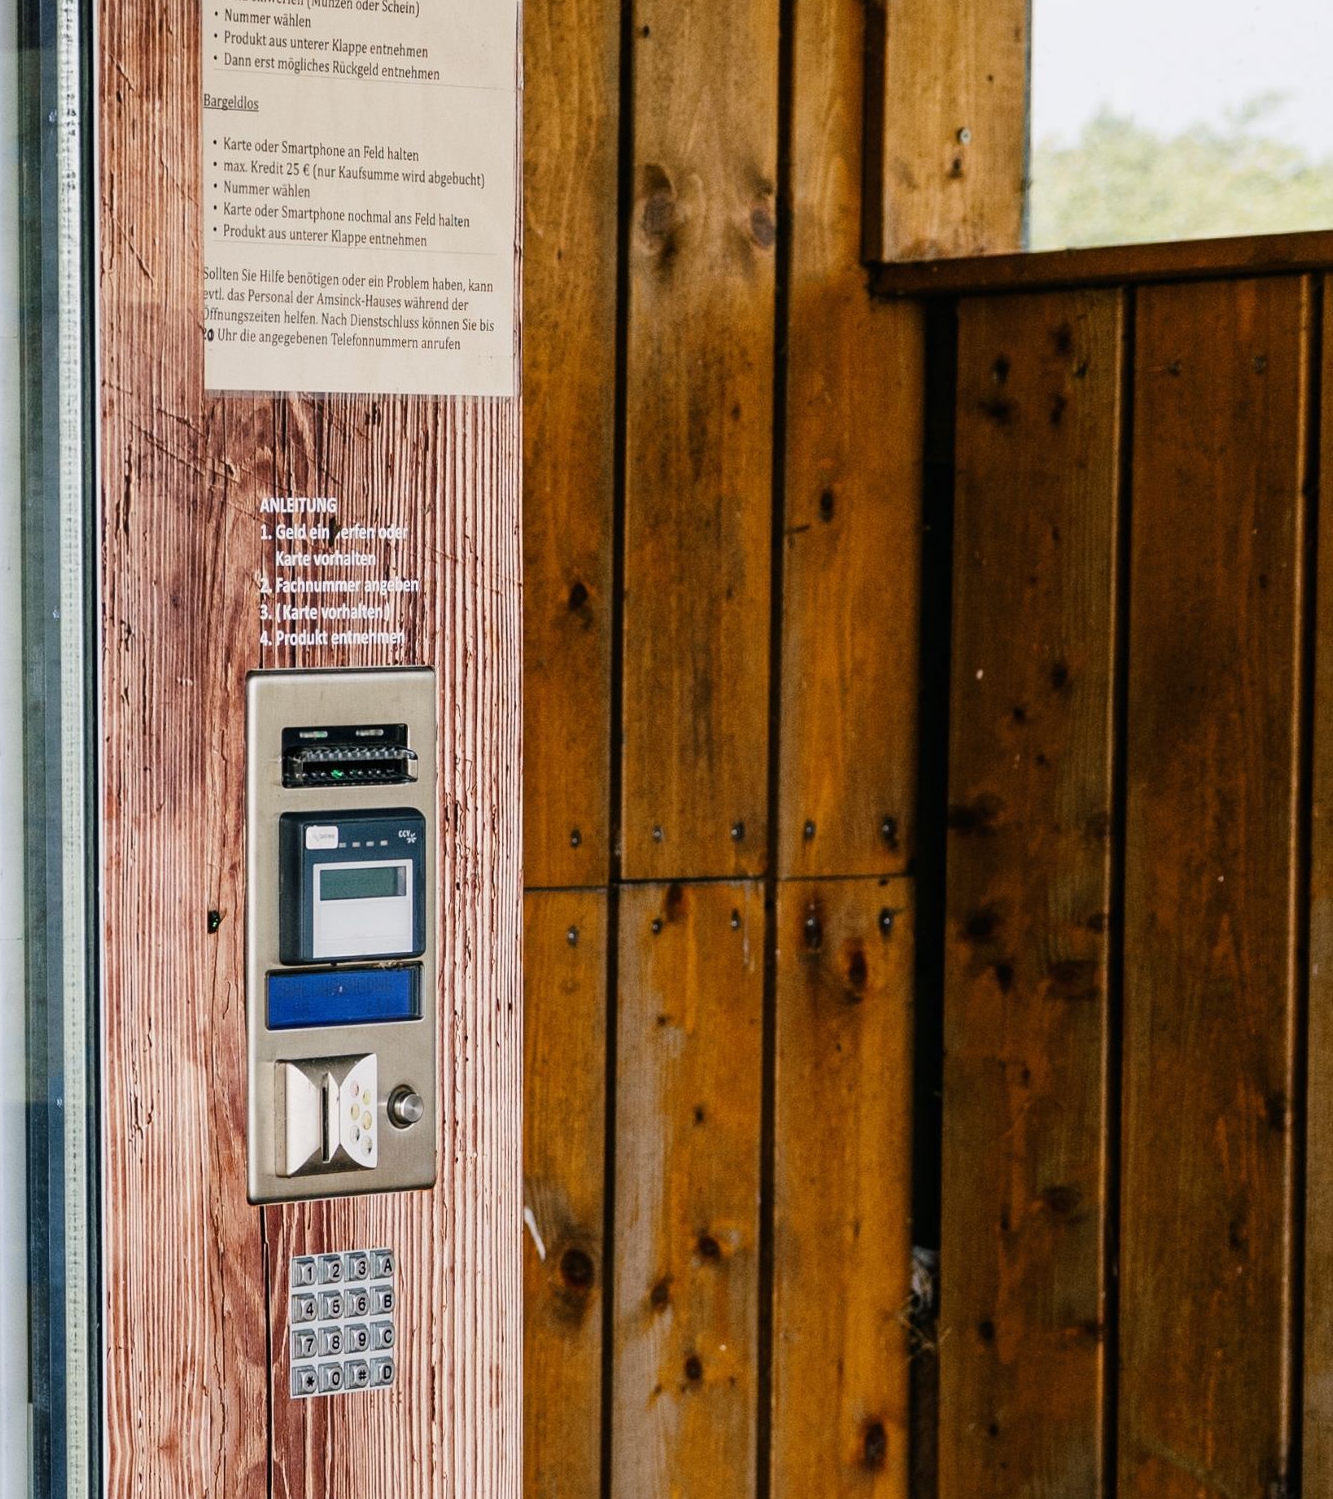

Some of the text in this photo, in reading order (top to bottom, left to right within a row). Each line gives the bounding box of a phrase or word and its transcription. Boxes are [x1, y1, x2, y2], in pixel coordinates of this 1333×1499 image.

[225, 8, 311, 28] Nummer wählen
[382, 0, 419, 18] Schein)
[225, 30, 428, 58] Produkt aus unterer Klappe entnehmen
[225, 52, 439, 80] Dann erst mögliches Rückgeld entnehmen
[203, 94, 259, 109] Bargeldlos
[224, 137, 419, 161] Karte oder Smartphone an Feld halten
[224, 160, 484, 189] max. Kredit 25 € (nur Kaufsumme wird abgebucht)
[203, 266, 493, 292] Sollten Sie Hilfe benötigen oder ein Problem haben, kann
[260, 497, 337, 513] ANLEITUNG
[260, 524, 408, 540] 1. Geld einerfen oder
[276, 551, 376, 566] Karte vorhalten
[260, 576, 420, 596] 2. Fachnummer angeben
[260, 629, 405, 646] 4. Produkt entnehmen
[307, 1258, 392, 1280] 1 2 3 A
[306, 1294, 392, 1316] 4 5 6 B
[306, 1329, 392, 1352] 7 8 9 C
[384, 1365, 391, 1379] D
